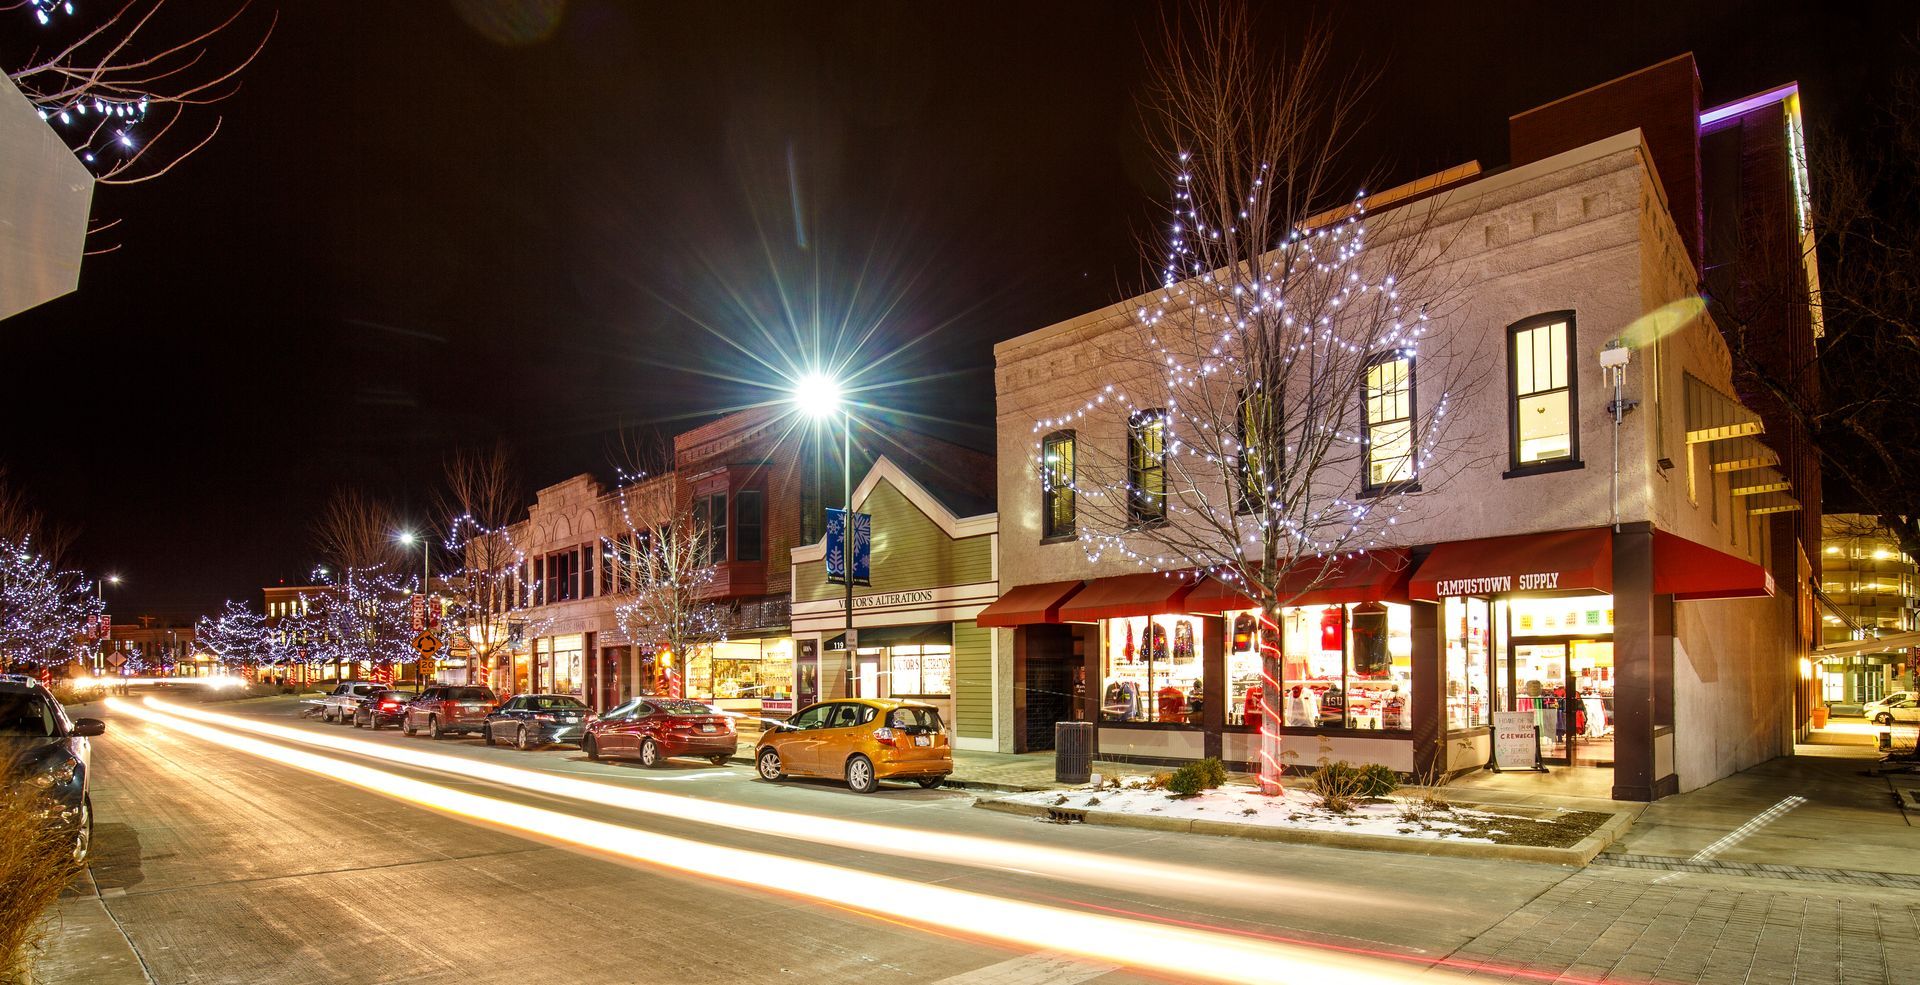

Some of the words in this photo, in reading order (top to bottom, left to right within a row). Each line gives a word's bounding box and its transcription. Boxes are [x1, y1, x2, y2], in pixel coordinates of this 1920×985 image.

[1436, 576, 1511, 596] CAMPUSTOWN
[1519, 572, 1559, 590] SUPPLY
[839, 597, 873, 609] VITOR'S
[876, 591, 932, 606] ALTERATIONS
[834, 641, 844, 649] 119
[421, 661, 434, 669] 20
